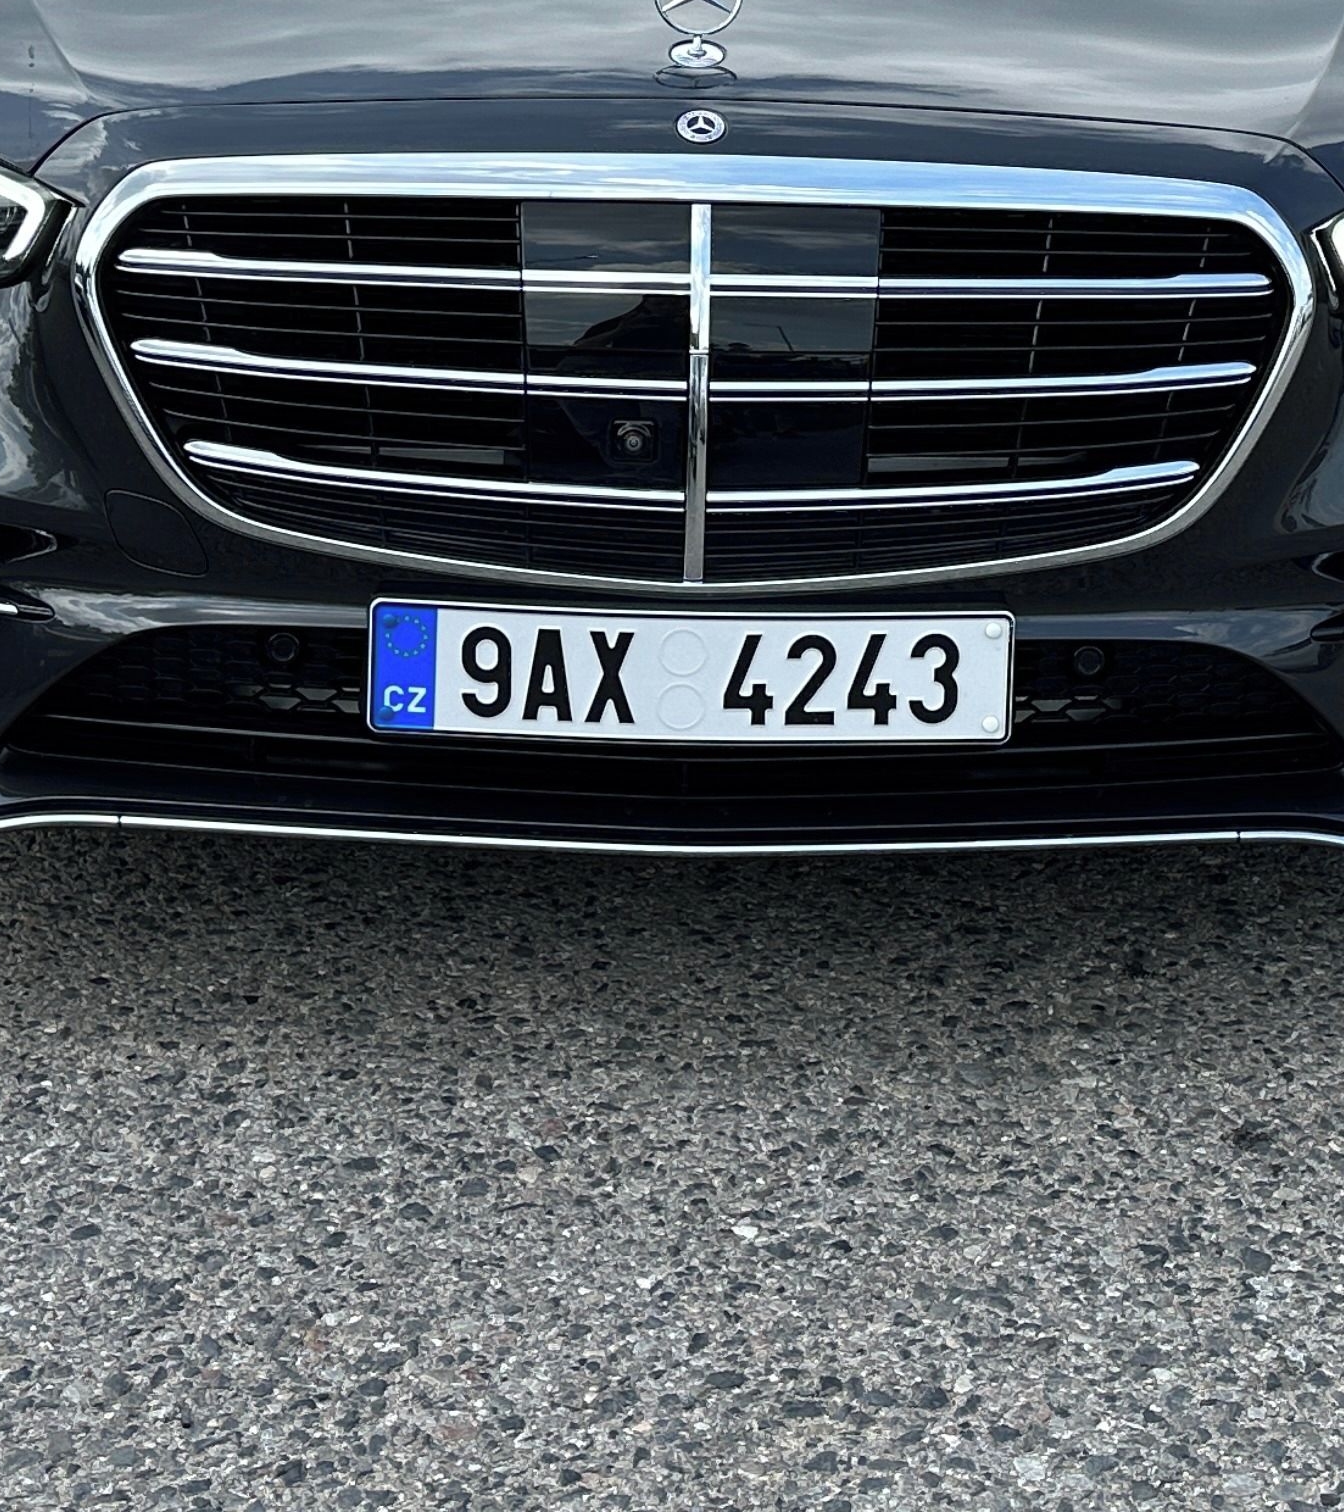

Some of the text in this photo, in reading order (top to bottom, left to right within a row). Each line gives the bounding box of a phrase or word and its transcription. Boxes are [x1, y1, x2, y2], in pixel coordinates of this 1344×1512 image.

[382, 625, 960, 726] CZ 9AX 4243
